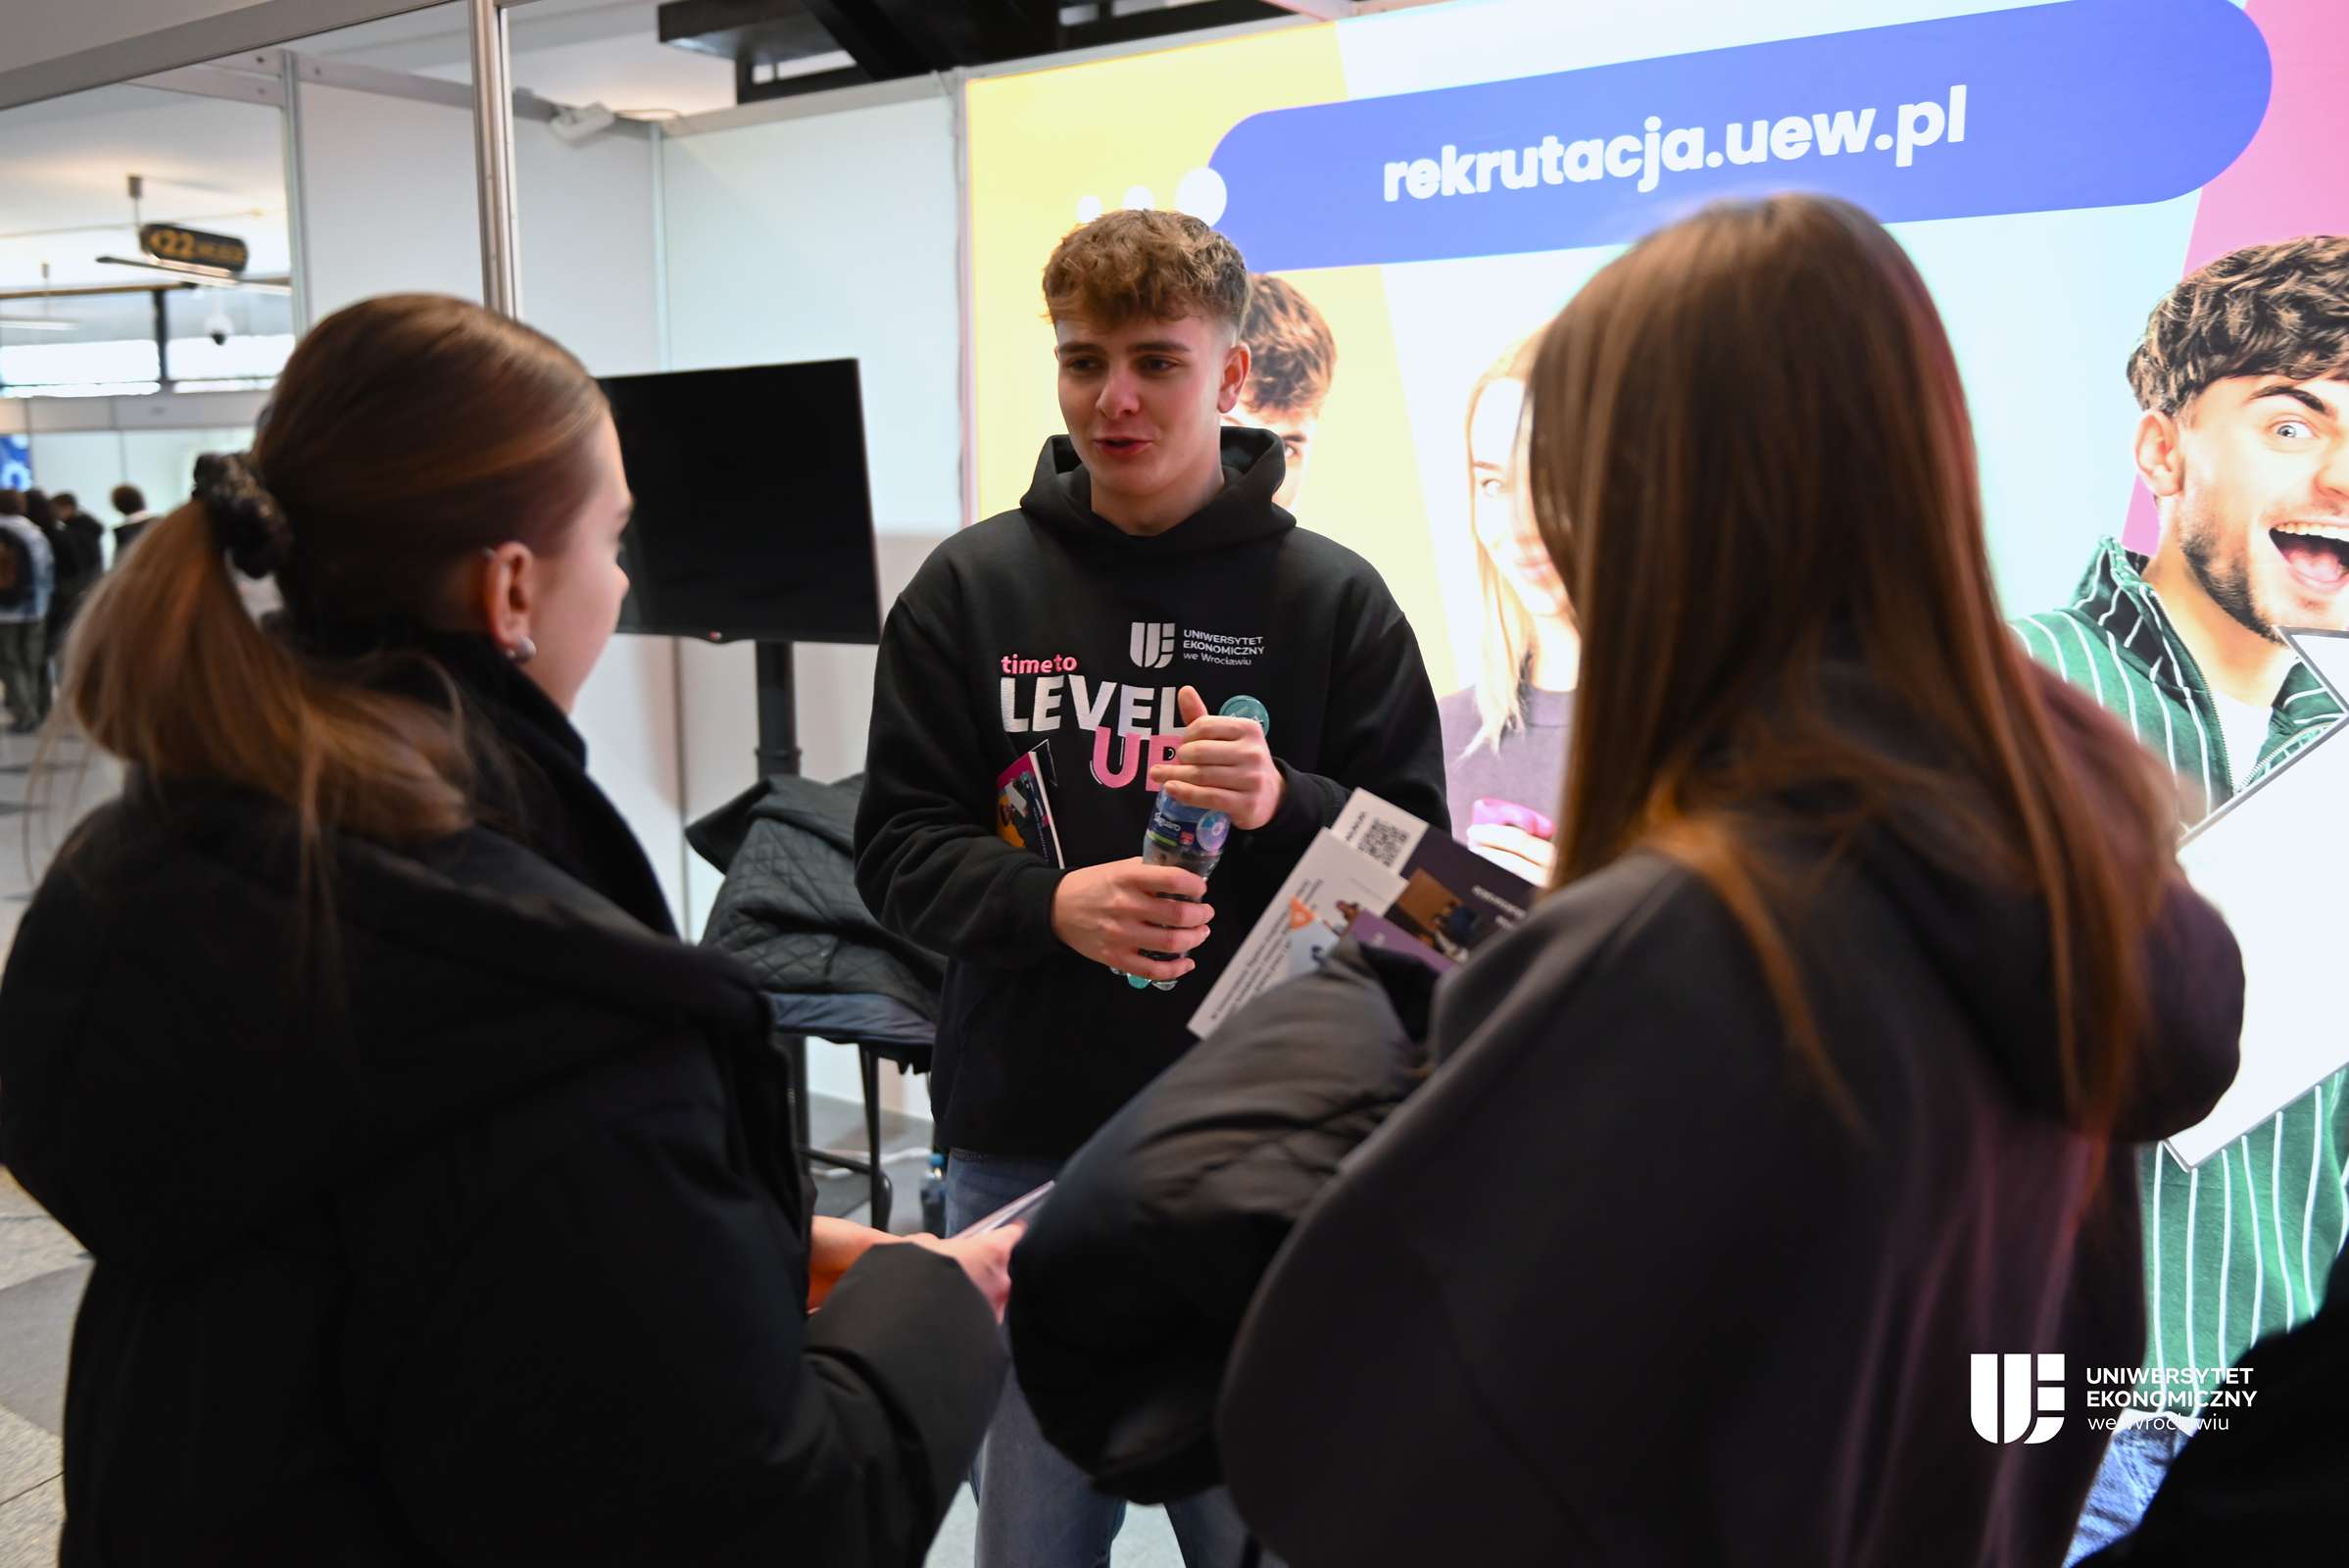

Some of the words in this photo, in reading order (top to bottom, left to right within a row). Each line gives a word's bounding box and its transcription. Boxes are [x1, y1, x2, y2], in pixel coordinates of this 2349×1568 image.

[1384, 84, 1967, 202] rekrutacja.uew.pl
[1183, 629, 1263, 646] UNIWERSYTET
[1183, 640, 1265, 656] EKONOMICZNY
[1200, 653, 1252, 665] Wrocławiu
[1001, 674, 1188, 740] LEVEL
